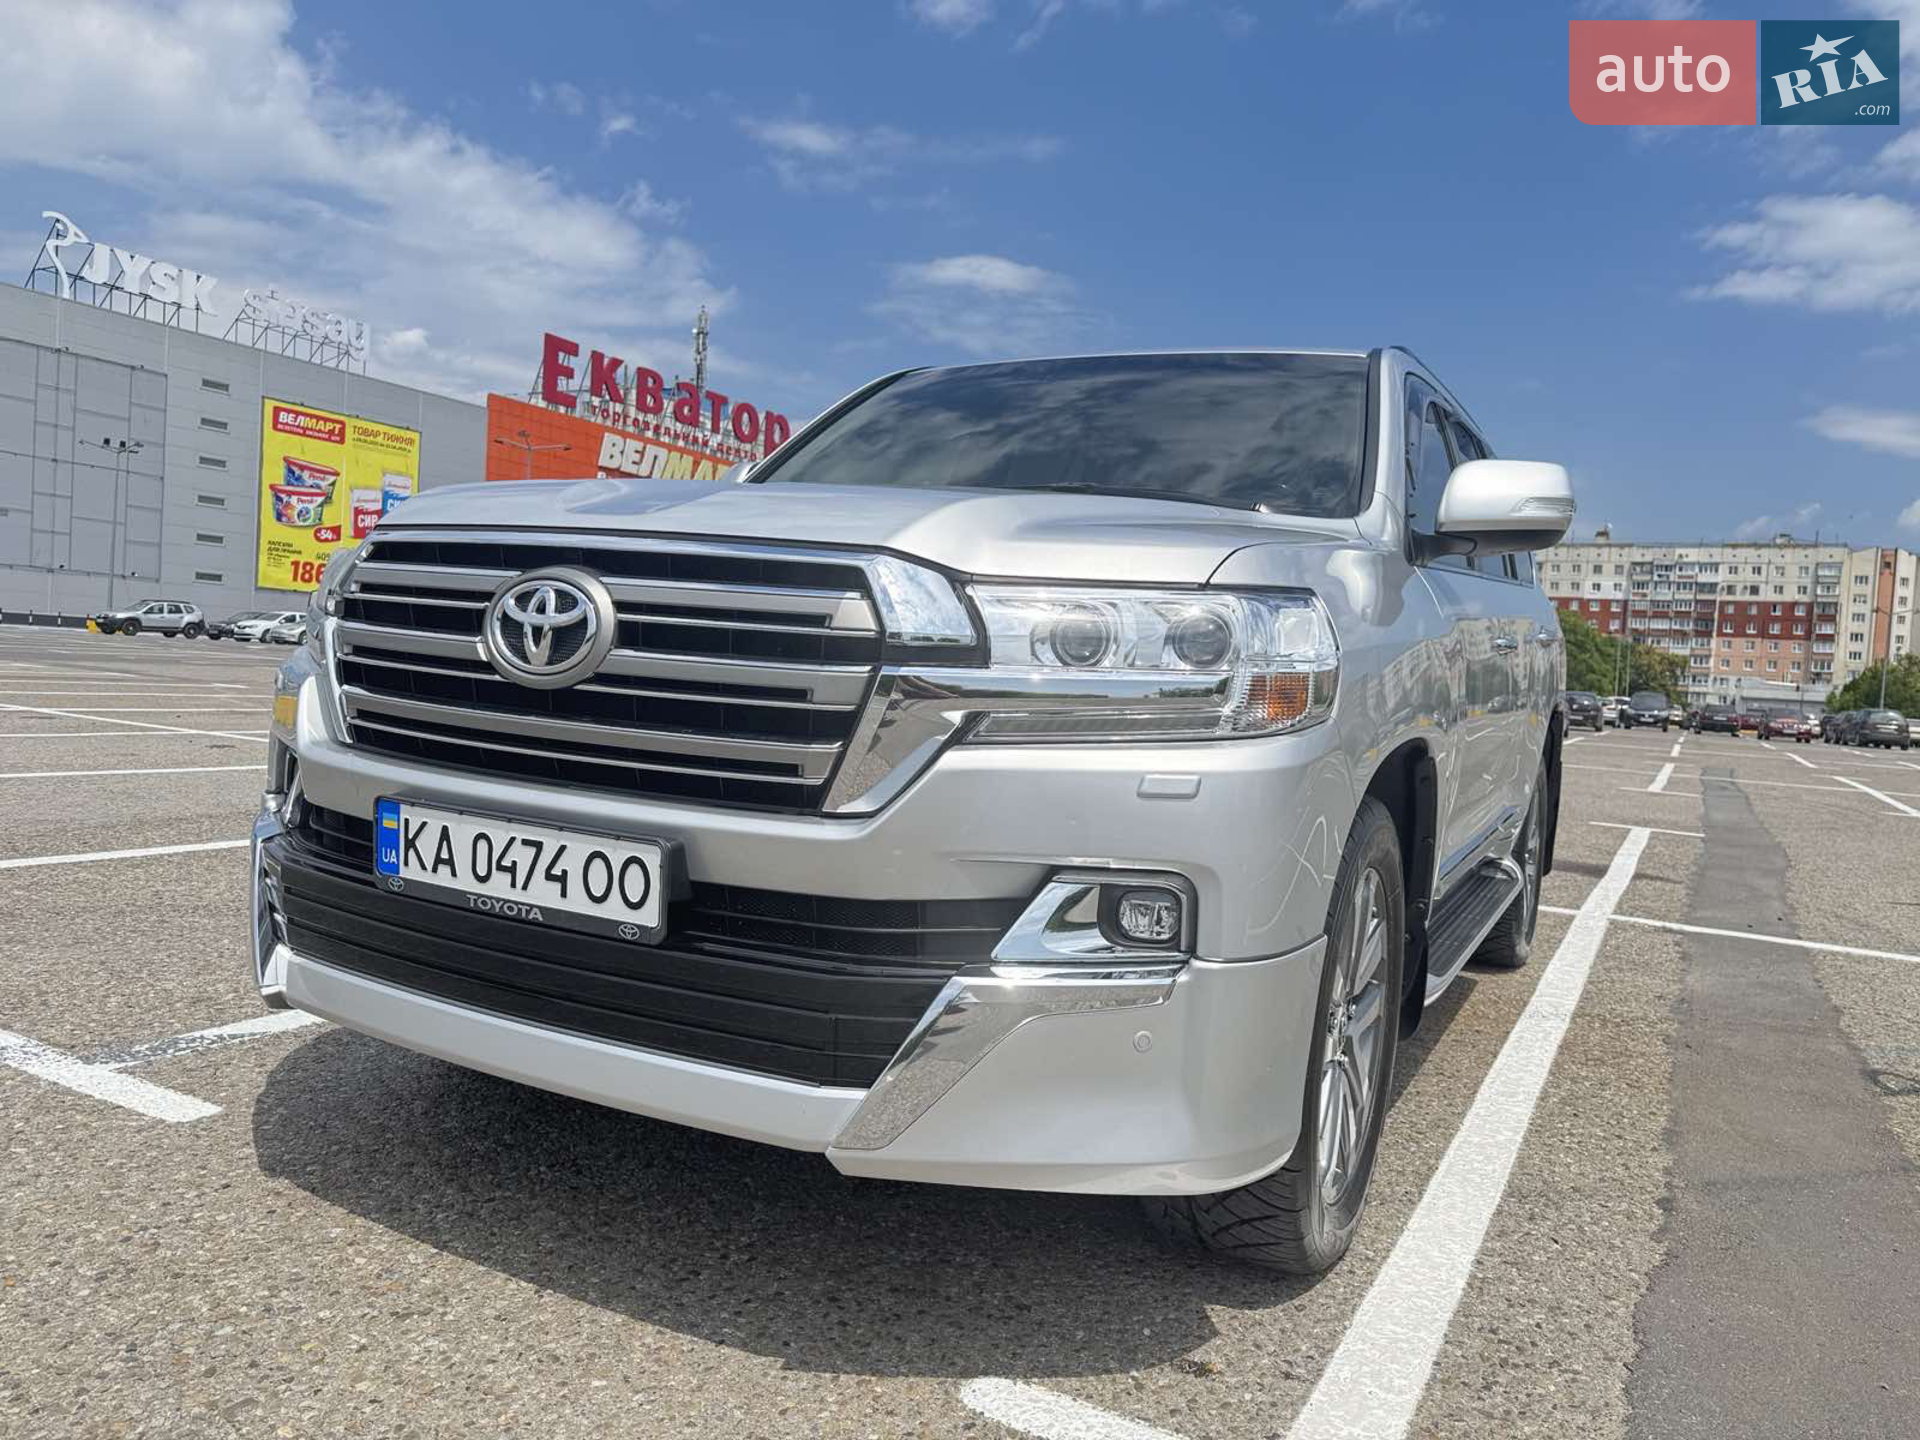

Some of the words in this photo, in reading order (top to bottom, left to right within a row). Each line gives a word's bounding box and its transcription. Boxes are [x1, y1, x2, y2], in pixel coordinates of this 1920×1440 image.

[81, 242, 219, 316] JYSK
[278, 411, 343, 435] ВЕЛМАРТ
[353, 425, 381, 438] ТОВАР
[381, 847, 398, 865] UA
[403, 817, 458, 878] KA
[470, 831, 568, 899] 0474
[466, 893, 544, 922] TOYOTA
